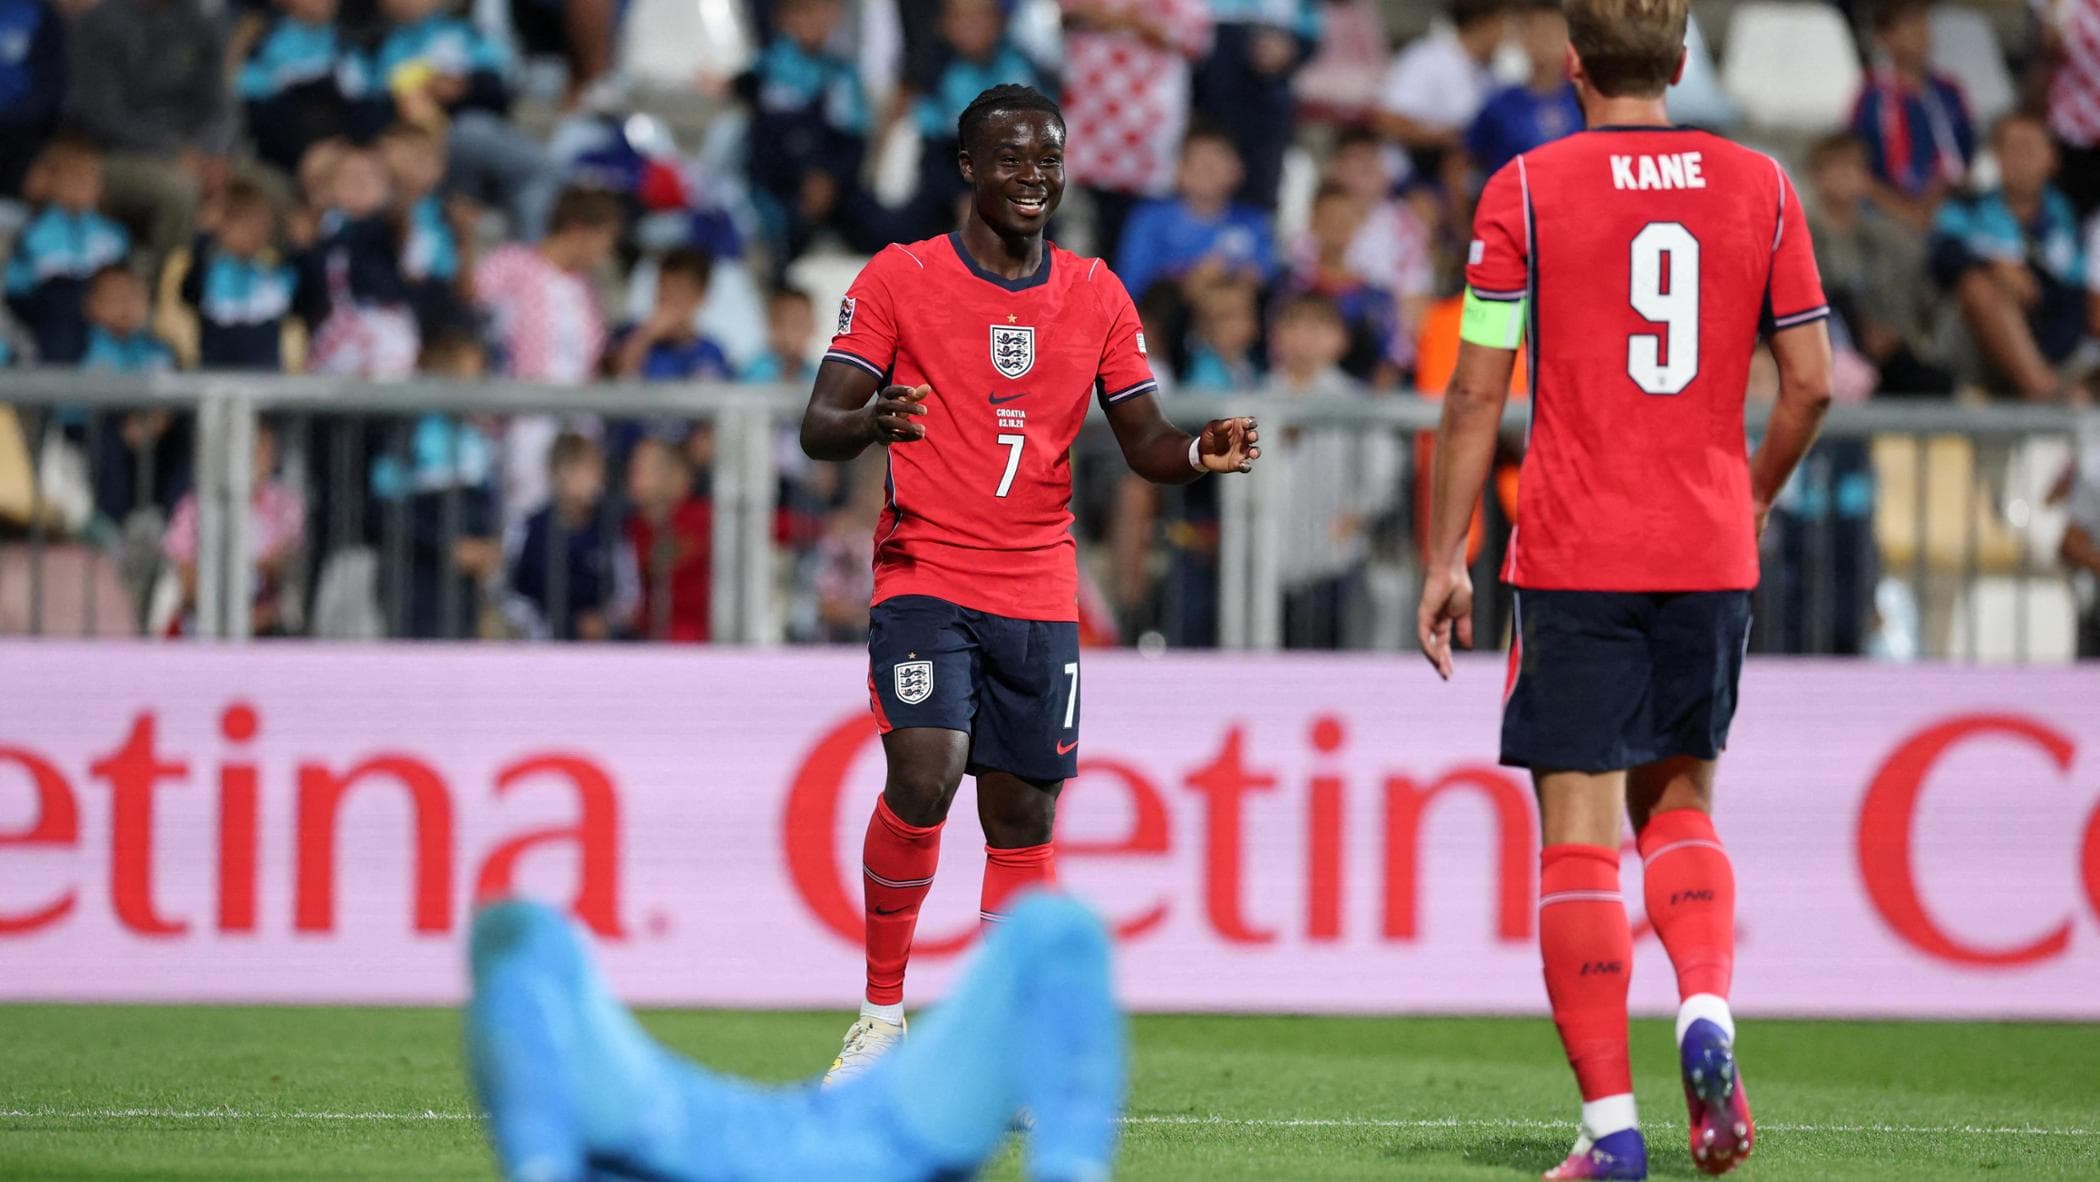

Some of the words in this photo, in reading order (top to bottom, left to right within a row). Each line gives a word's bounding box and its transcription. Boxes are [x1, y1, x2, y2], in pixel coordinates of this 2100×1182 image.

[1609, 151, 1706, 190] KANE
[1626, 221, 1700, 395] 9
[996, 408, 1026, 418] CROATIA
[995, 433, 1025, 498] 7
[1062, 661, 1079, 729] 7
[1671, 890, 1714, 905] ENG
[1581, 961, 1622, 976] ENG
